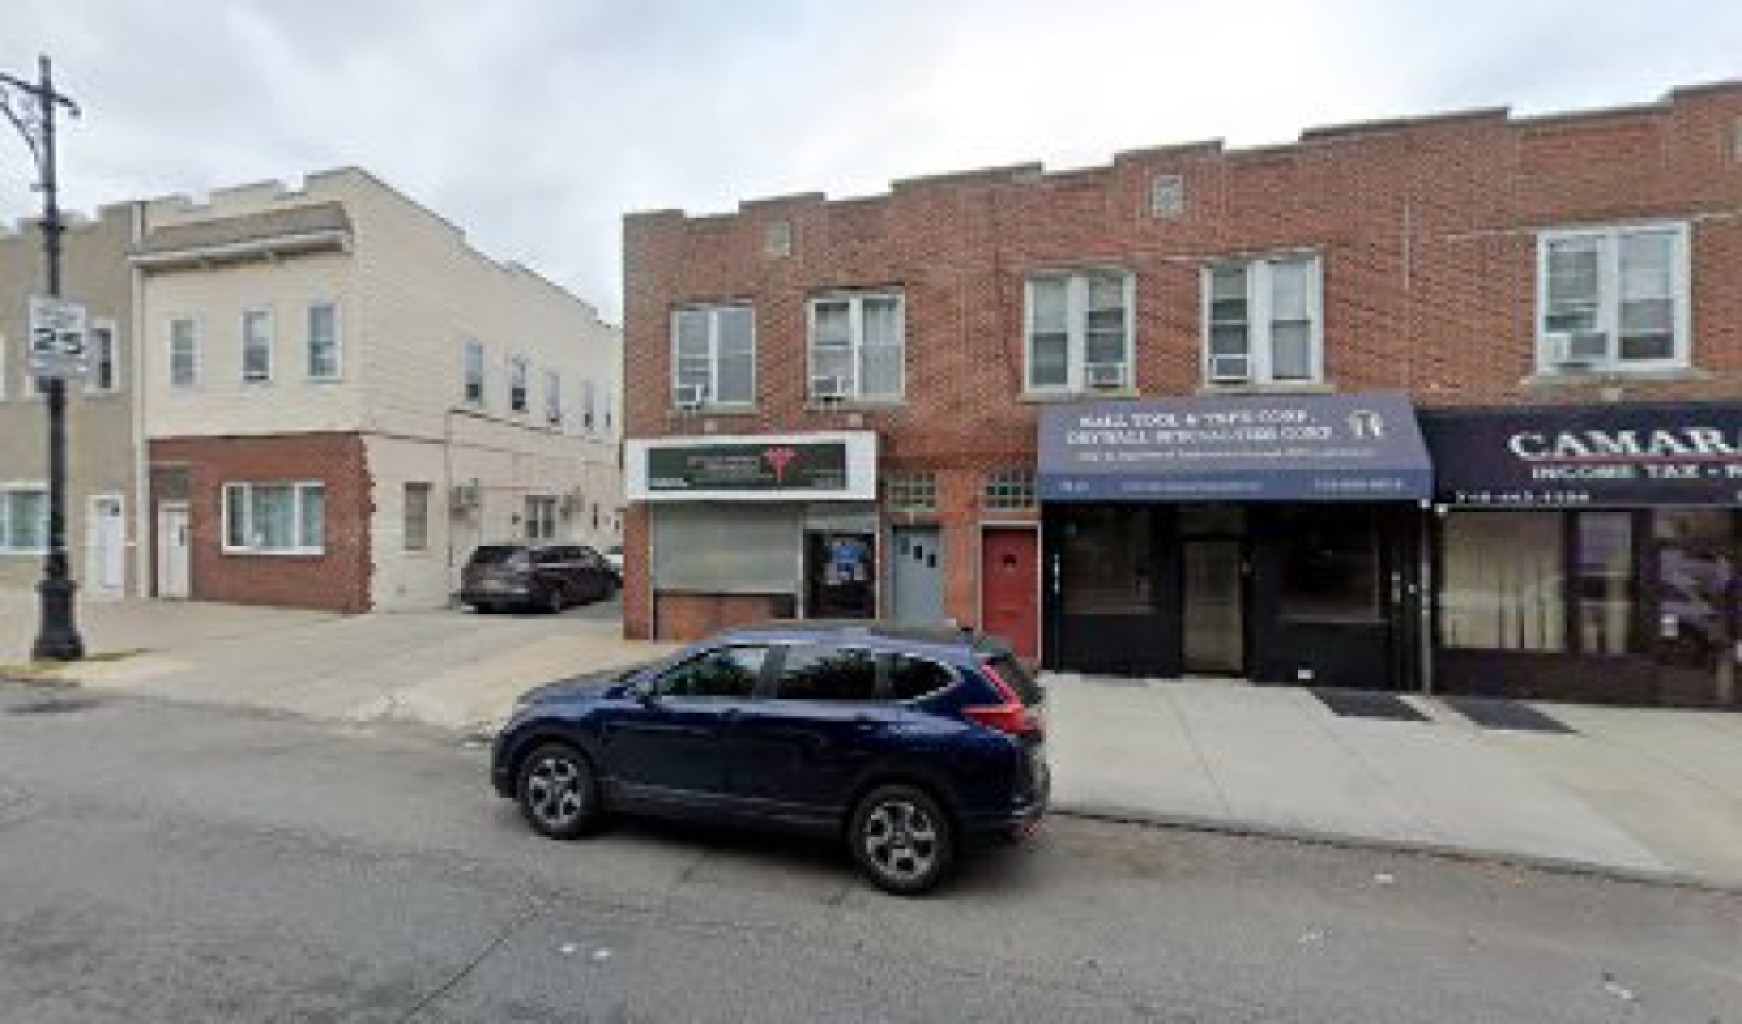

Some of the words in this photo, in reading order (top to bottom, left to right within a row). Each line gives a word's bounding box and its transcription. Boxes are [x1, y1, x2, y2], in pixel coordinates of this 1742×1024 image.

[33, 328, 84, 355] 25
[1131, 412, 1179, 428] TOOL
[1507, 429, 1742, 461] CAMAR
[1532, 465, 1638, 479] INCOME
[1645, 464, 1700, 479] TAX
